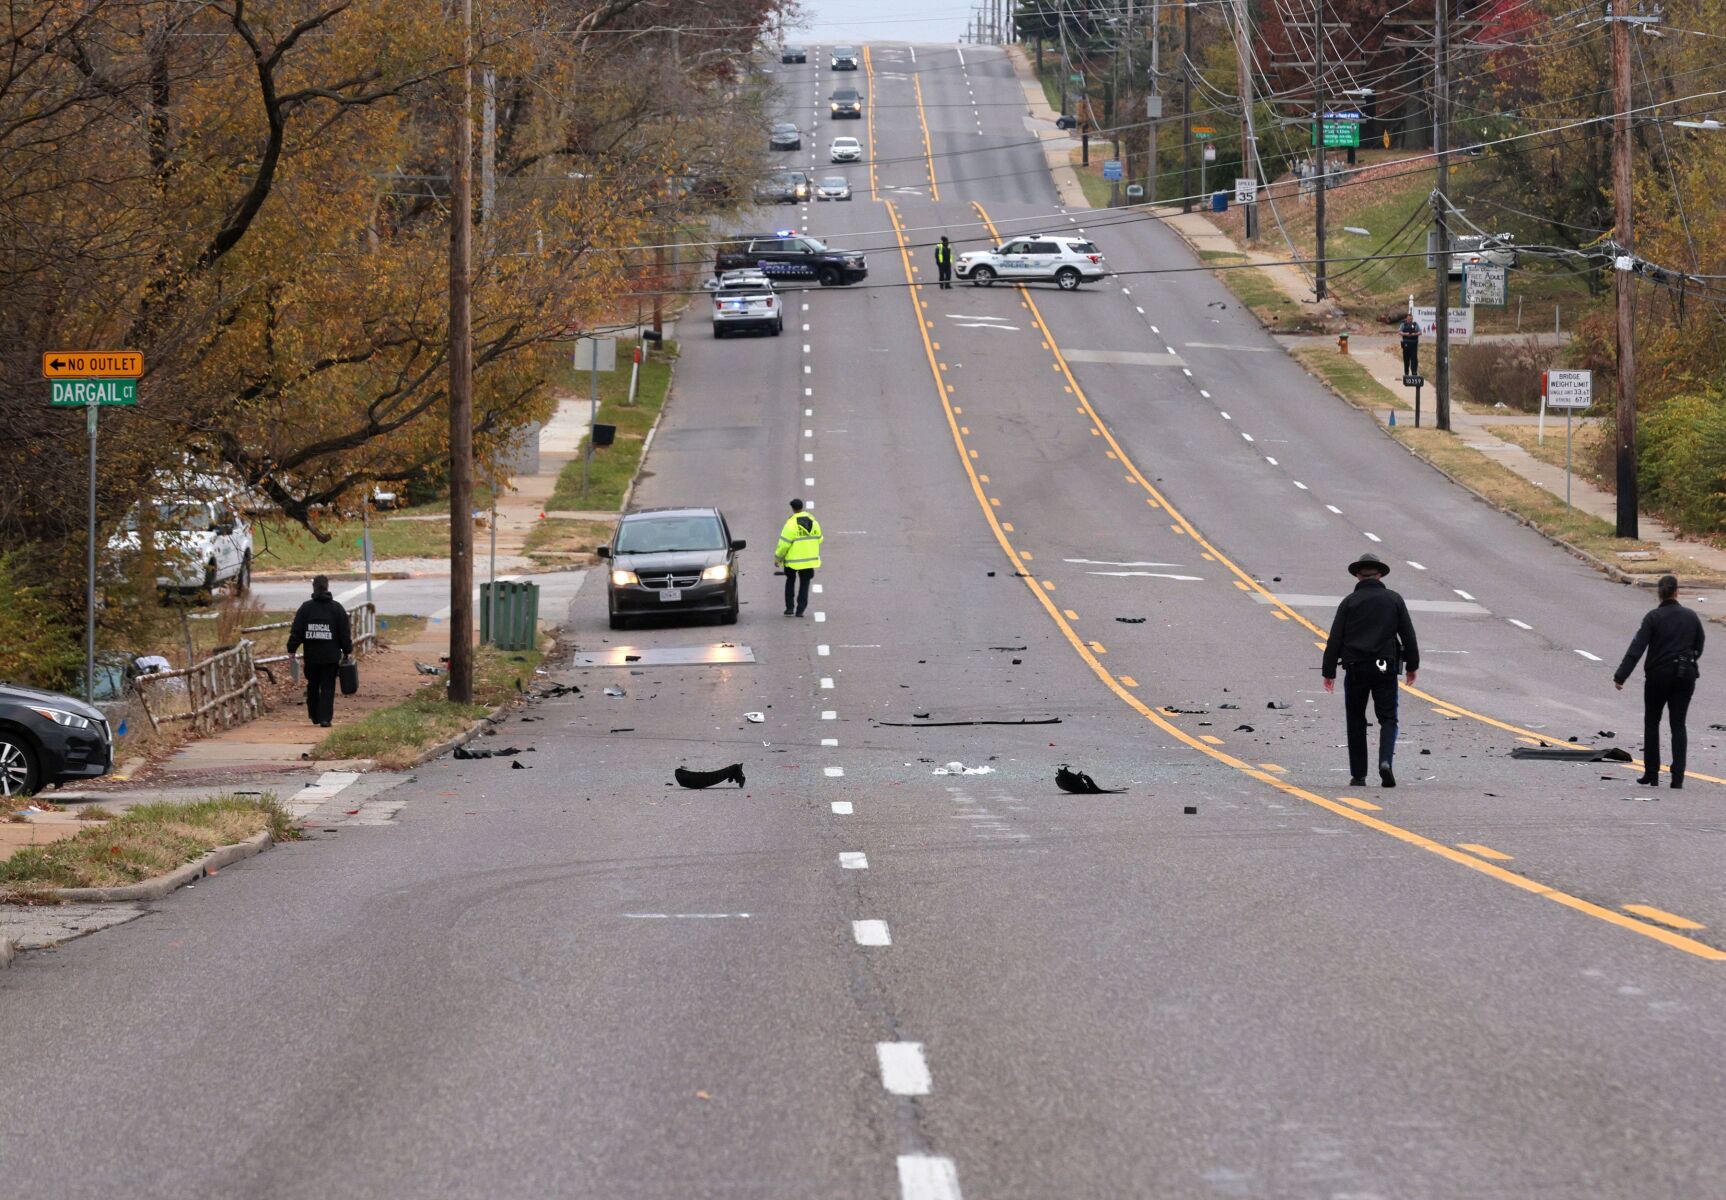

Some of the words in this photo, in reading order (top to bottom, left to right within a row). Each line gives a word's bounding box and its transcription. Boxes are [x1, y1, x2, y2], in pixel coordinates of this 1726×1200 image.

[1238, 192, 1254, 202] 35
[1485, 272, 1504, 280] ADULT
[1470, 280, 1496, 288] MEDICAL
[68, 358, 84, 370] NO
[90, 358, 136, 370] OUTLET
[53, 383, 122, 402] DARGAIL
[123, 386, 134, 398] CT
[308, 623, 330, 632] MEDICAL
[305, 631, 333, 640] EXAMINER
